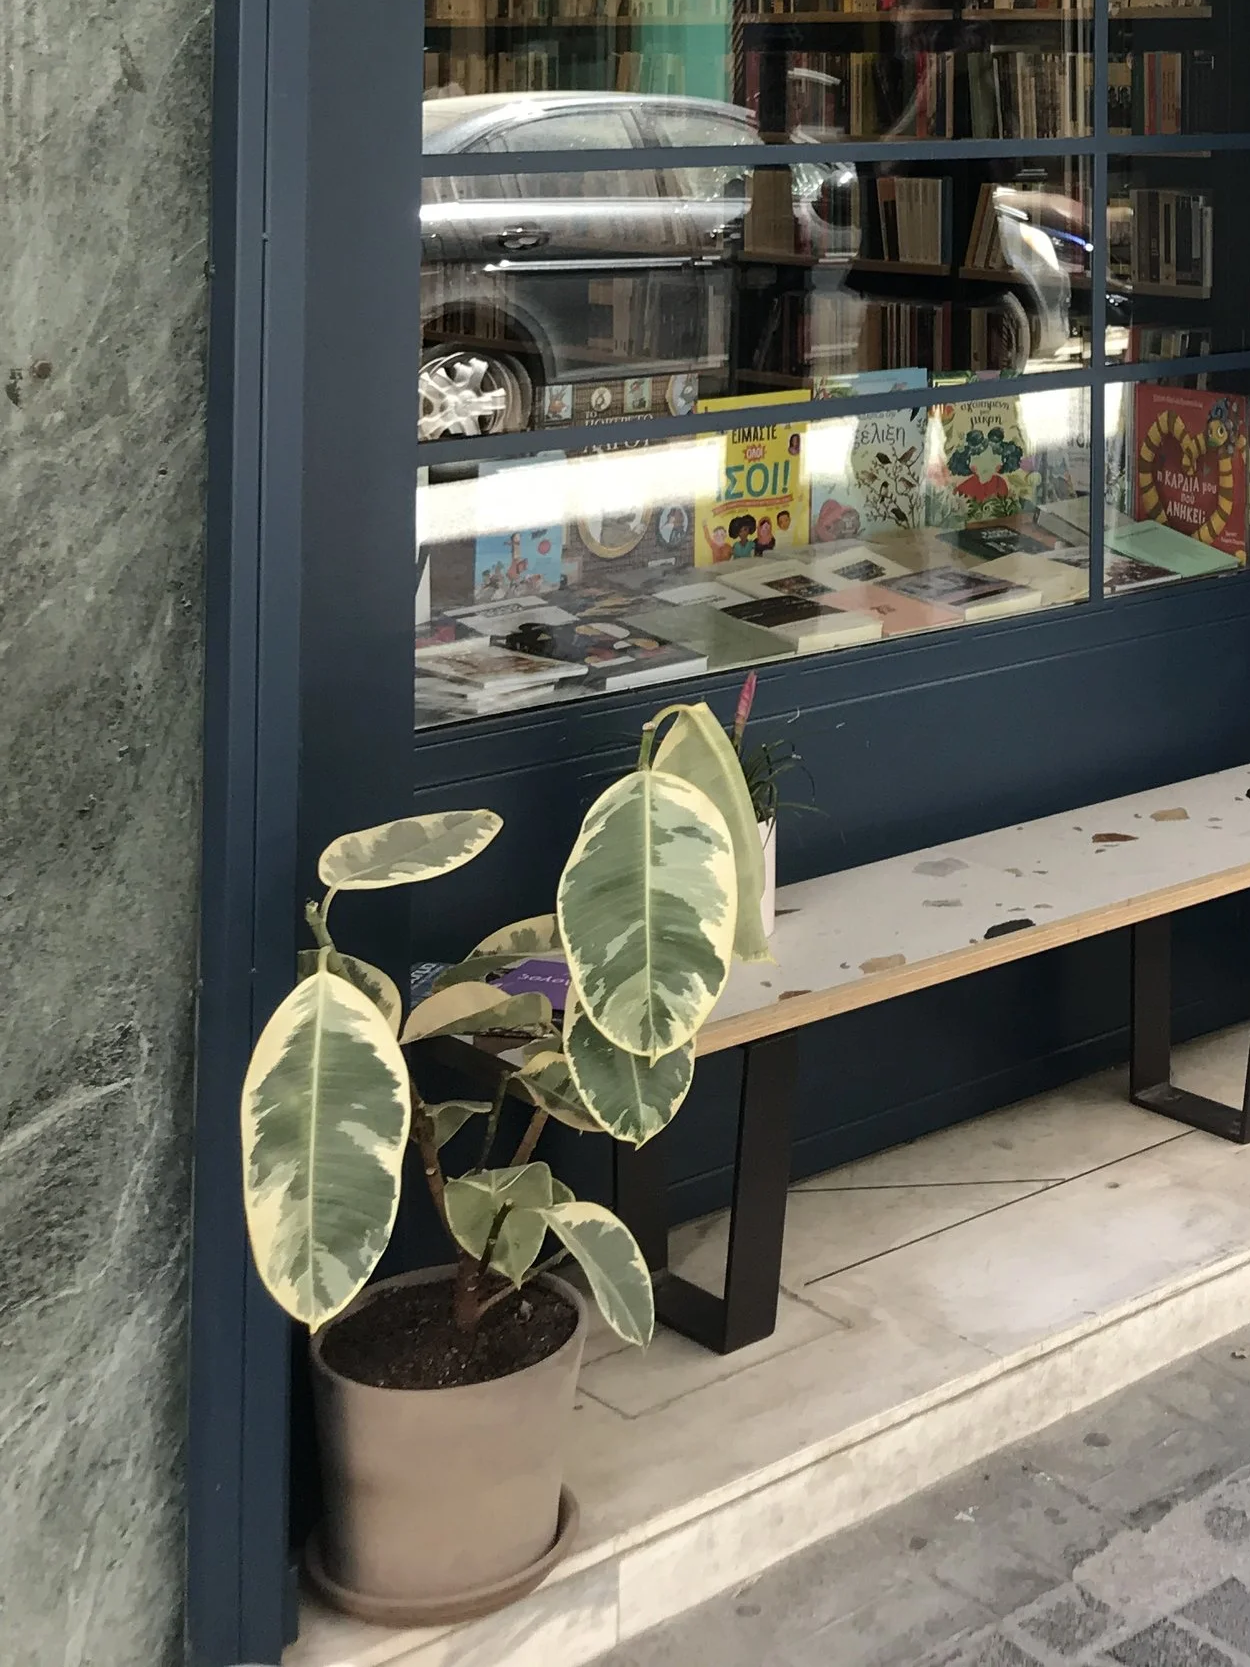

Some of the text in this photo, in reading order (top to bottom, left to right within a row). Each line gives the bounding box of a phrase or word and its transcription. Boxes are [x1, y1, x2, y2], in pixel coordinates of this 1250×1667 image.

[716, 460, 791, 502] ΣΟΙ!
[1165, 471, 1200, 494] ΚΑΡΔΙΑ
[1202, 482, 1217, 495] μου
